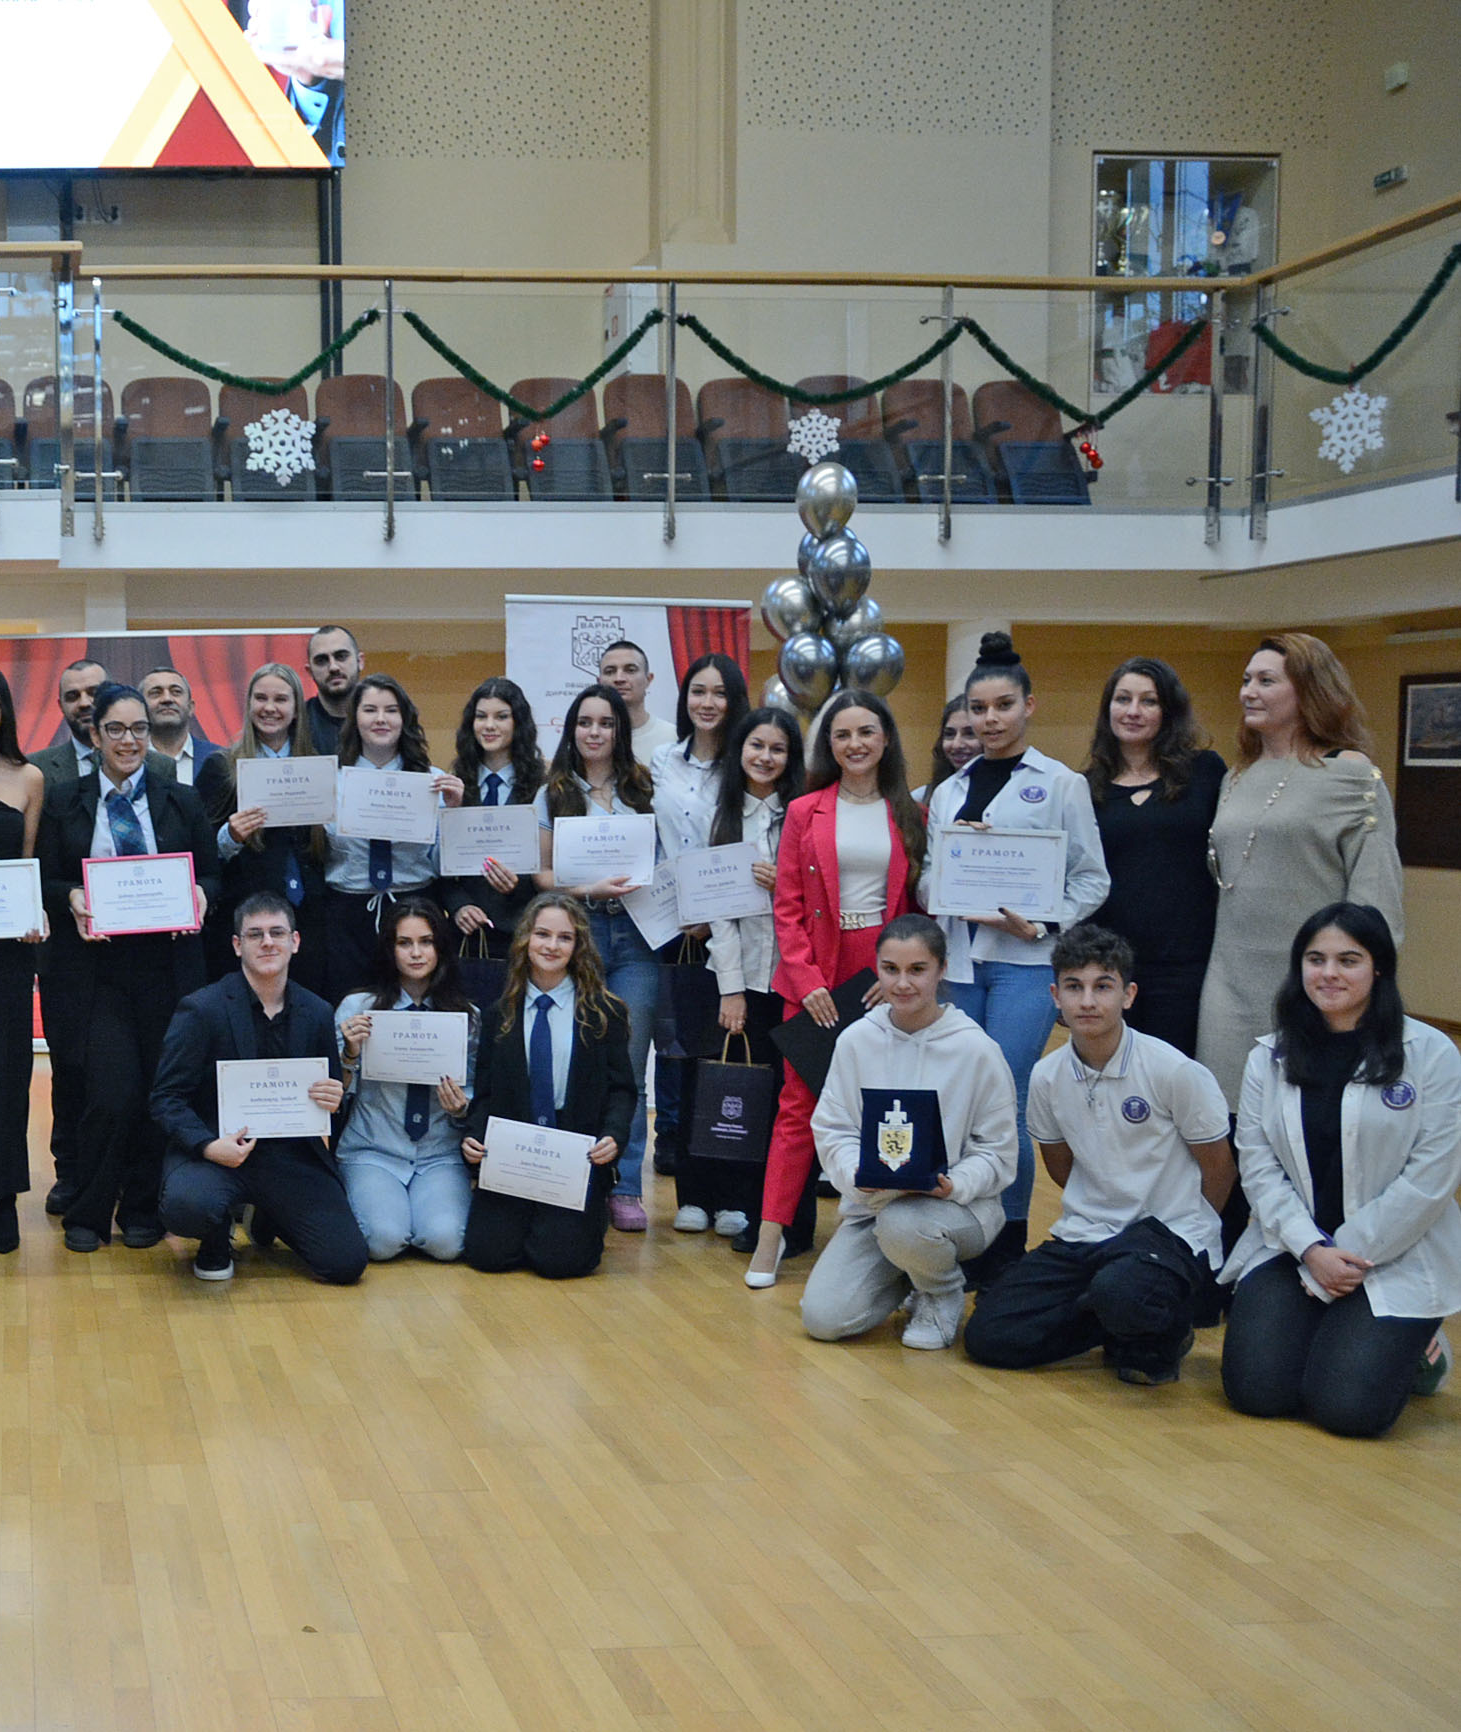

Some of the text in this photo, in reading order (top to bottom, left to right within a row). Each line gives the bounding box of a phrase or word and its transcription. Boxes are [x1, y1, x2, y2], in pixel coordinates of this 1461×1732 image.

[580, 621, 617, 630] ВАРНА
[266, 776, 311, 785] ГРАМОТА
[368, 788, 412, 798] ГРАМОТА
[467, 824, 512, 833] ГРАМОТА
[971, 848, 1026, 859] ГРАМОТА
[392, 1031, 439, 1040] ГРАМОТА
[249, 1080, 299, 1089] ГРАМОТА
[514, 1143, 562, 1159] ГРАМОТА
